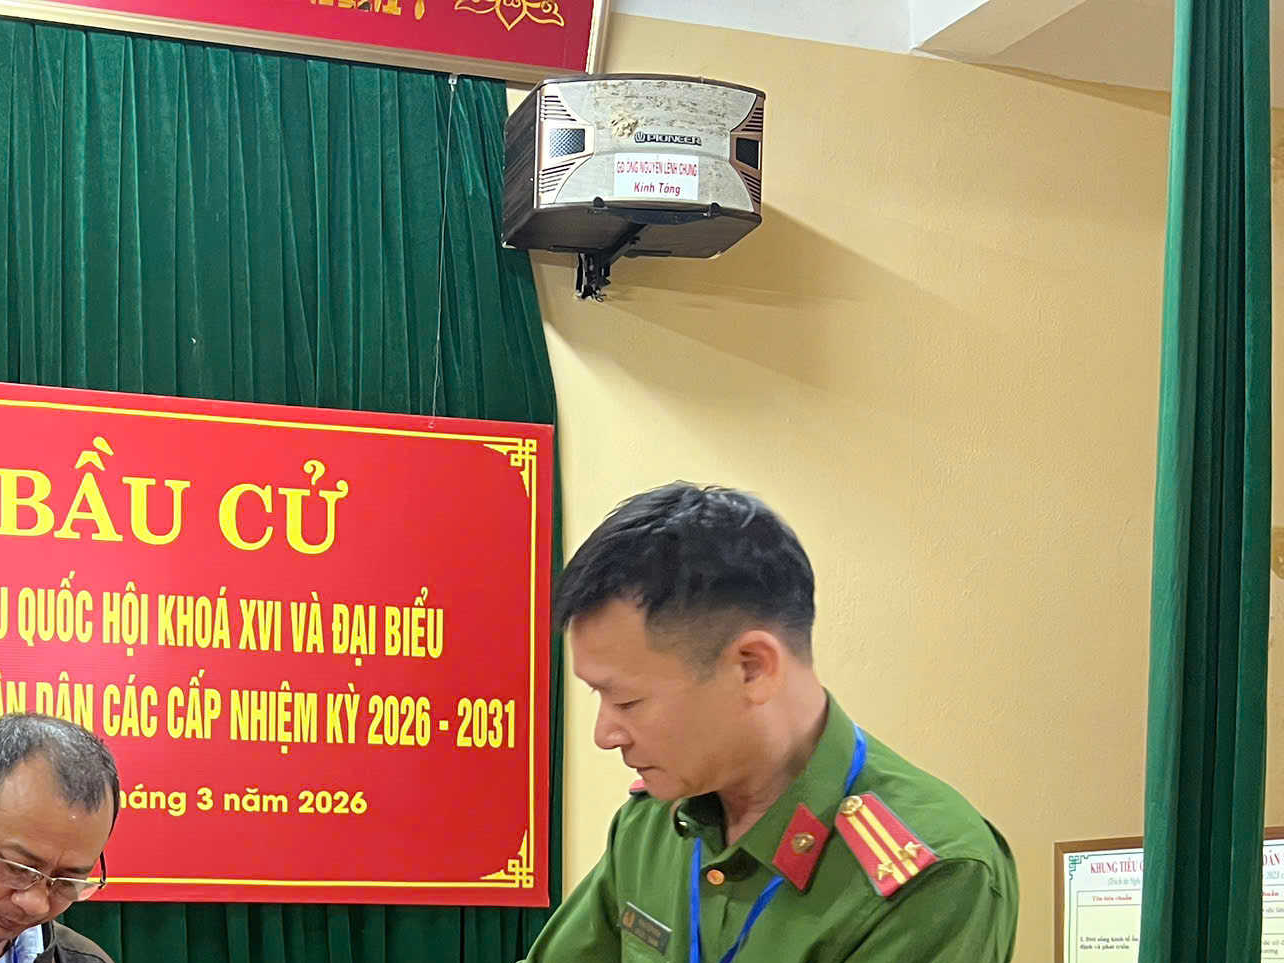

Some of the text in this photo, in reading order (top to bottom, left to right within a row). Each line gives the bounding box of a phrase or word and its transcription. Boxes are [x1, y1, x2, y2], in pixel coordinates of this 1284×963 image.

[646, 134, 702, 145] PIONEER
[219, 459, 349, 554] CỬ
[18, 570, 93, 647] QUỐC
[102, 581, 149, 656] HỘI
[158, 586, 231, 649] KHOÁ
[239, 598, 282, 652] XVI
[290, 591, 325, 653] VÀ
[331, 603, 376, 667] ĐẠI
[385, 586, 444, 658] BIỂU
[35, 671, 94, 733] DÂN
[102, 674, 158, 738] CÁC
[167, 669, 222, 740] CẤP
[230, 680, 318, 754] NHIỆM
[326, 682, 361, 744] KỲ
[368, 694, 431, 747] 2026
[439, 719, 449, 731] -
[456, 697, 515, 748] 2031
[119, 784, 368, 817] áng 3 năm 2026
[1090, 861, 1118, 874] KHUNG
